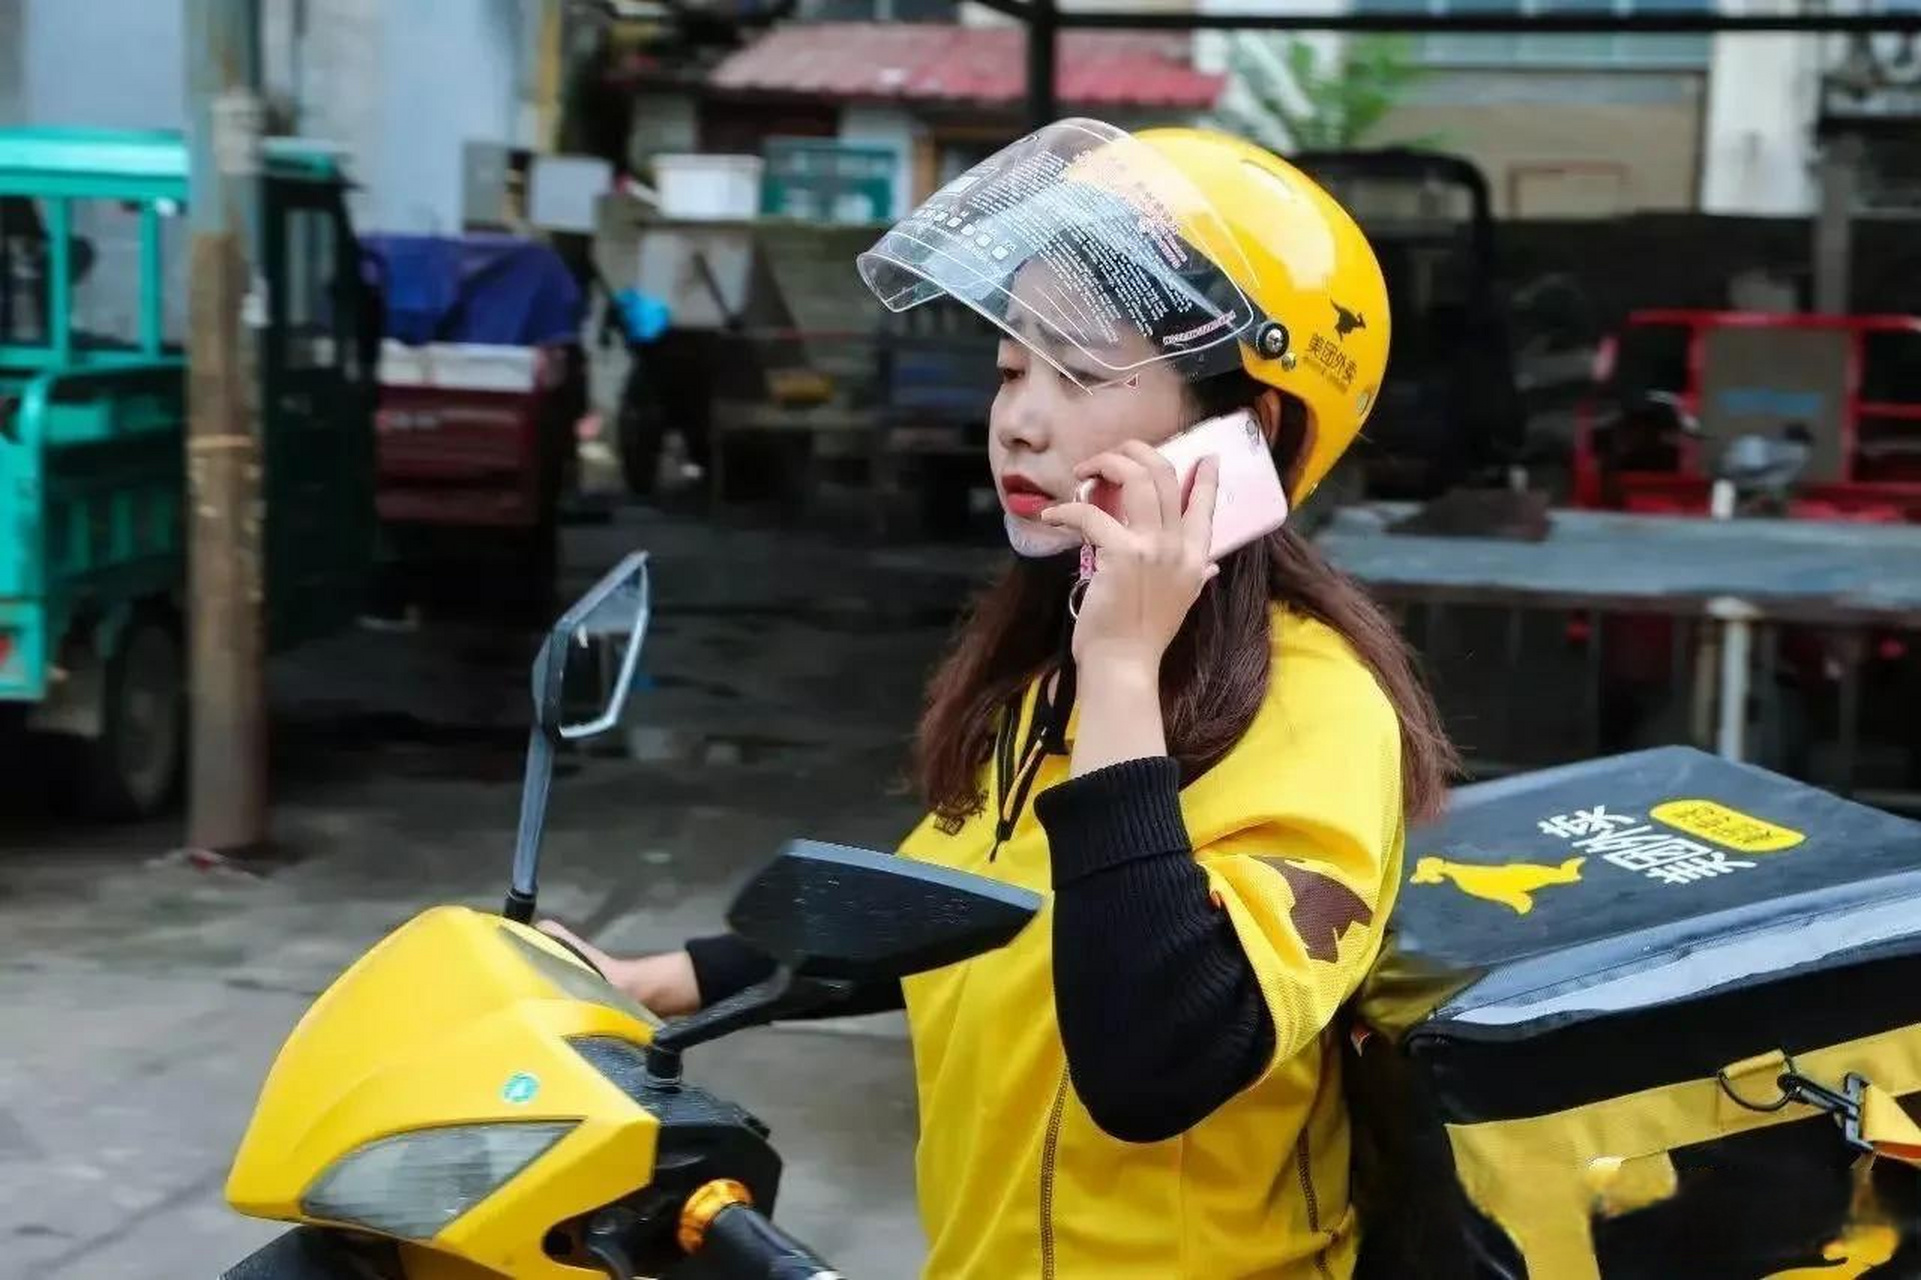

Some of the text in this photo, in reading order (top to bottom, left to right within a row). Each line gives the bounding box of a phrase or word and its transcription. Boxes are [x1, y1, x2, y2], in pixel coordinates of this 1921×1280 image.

[1304, 332, 1358, 385] 美团外卖
[1537, 805, 1758, 885] 美团外卖
